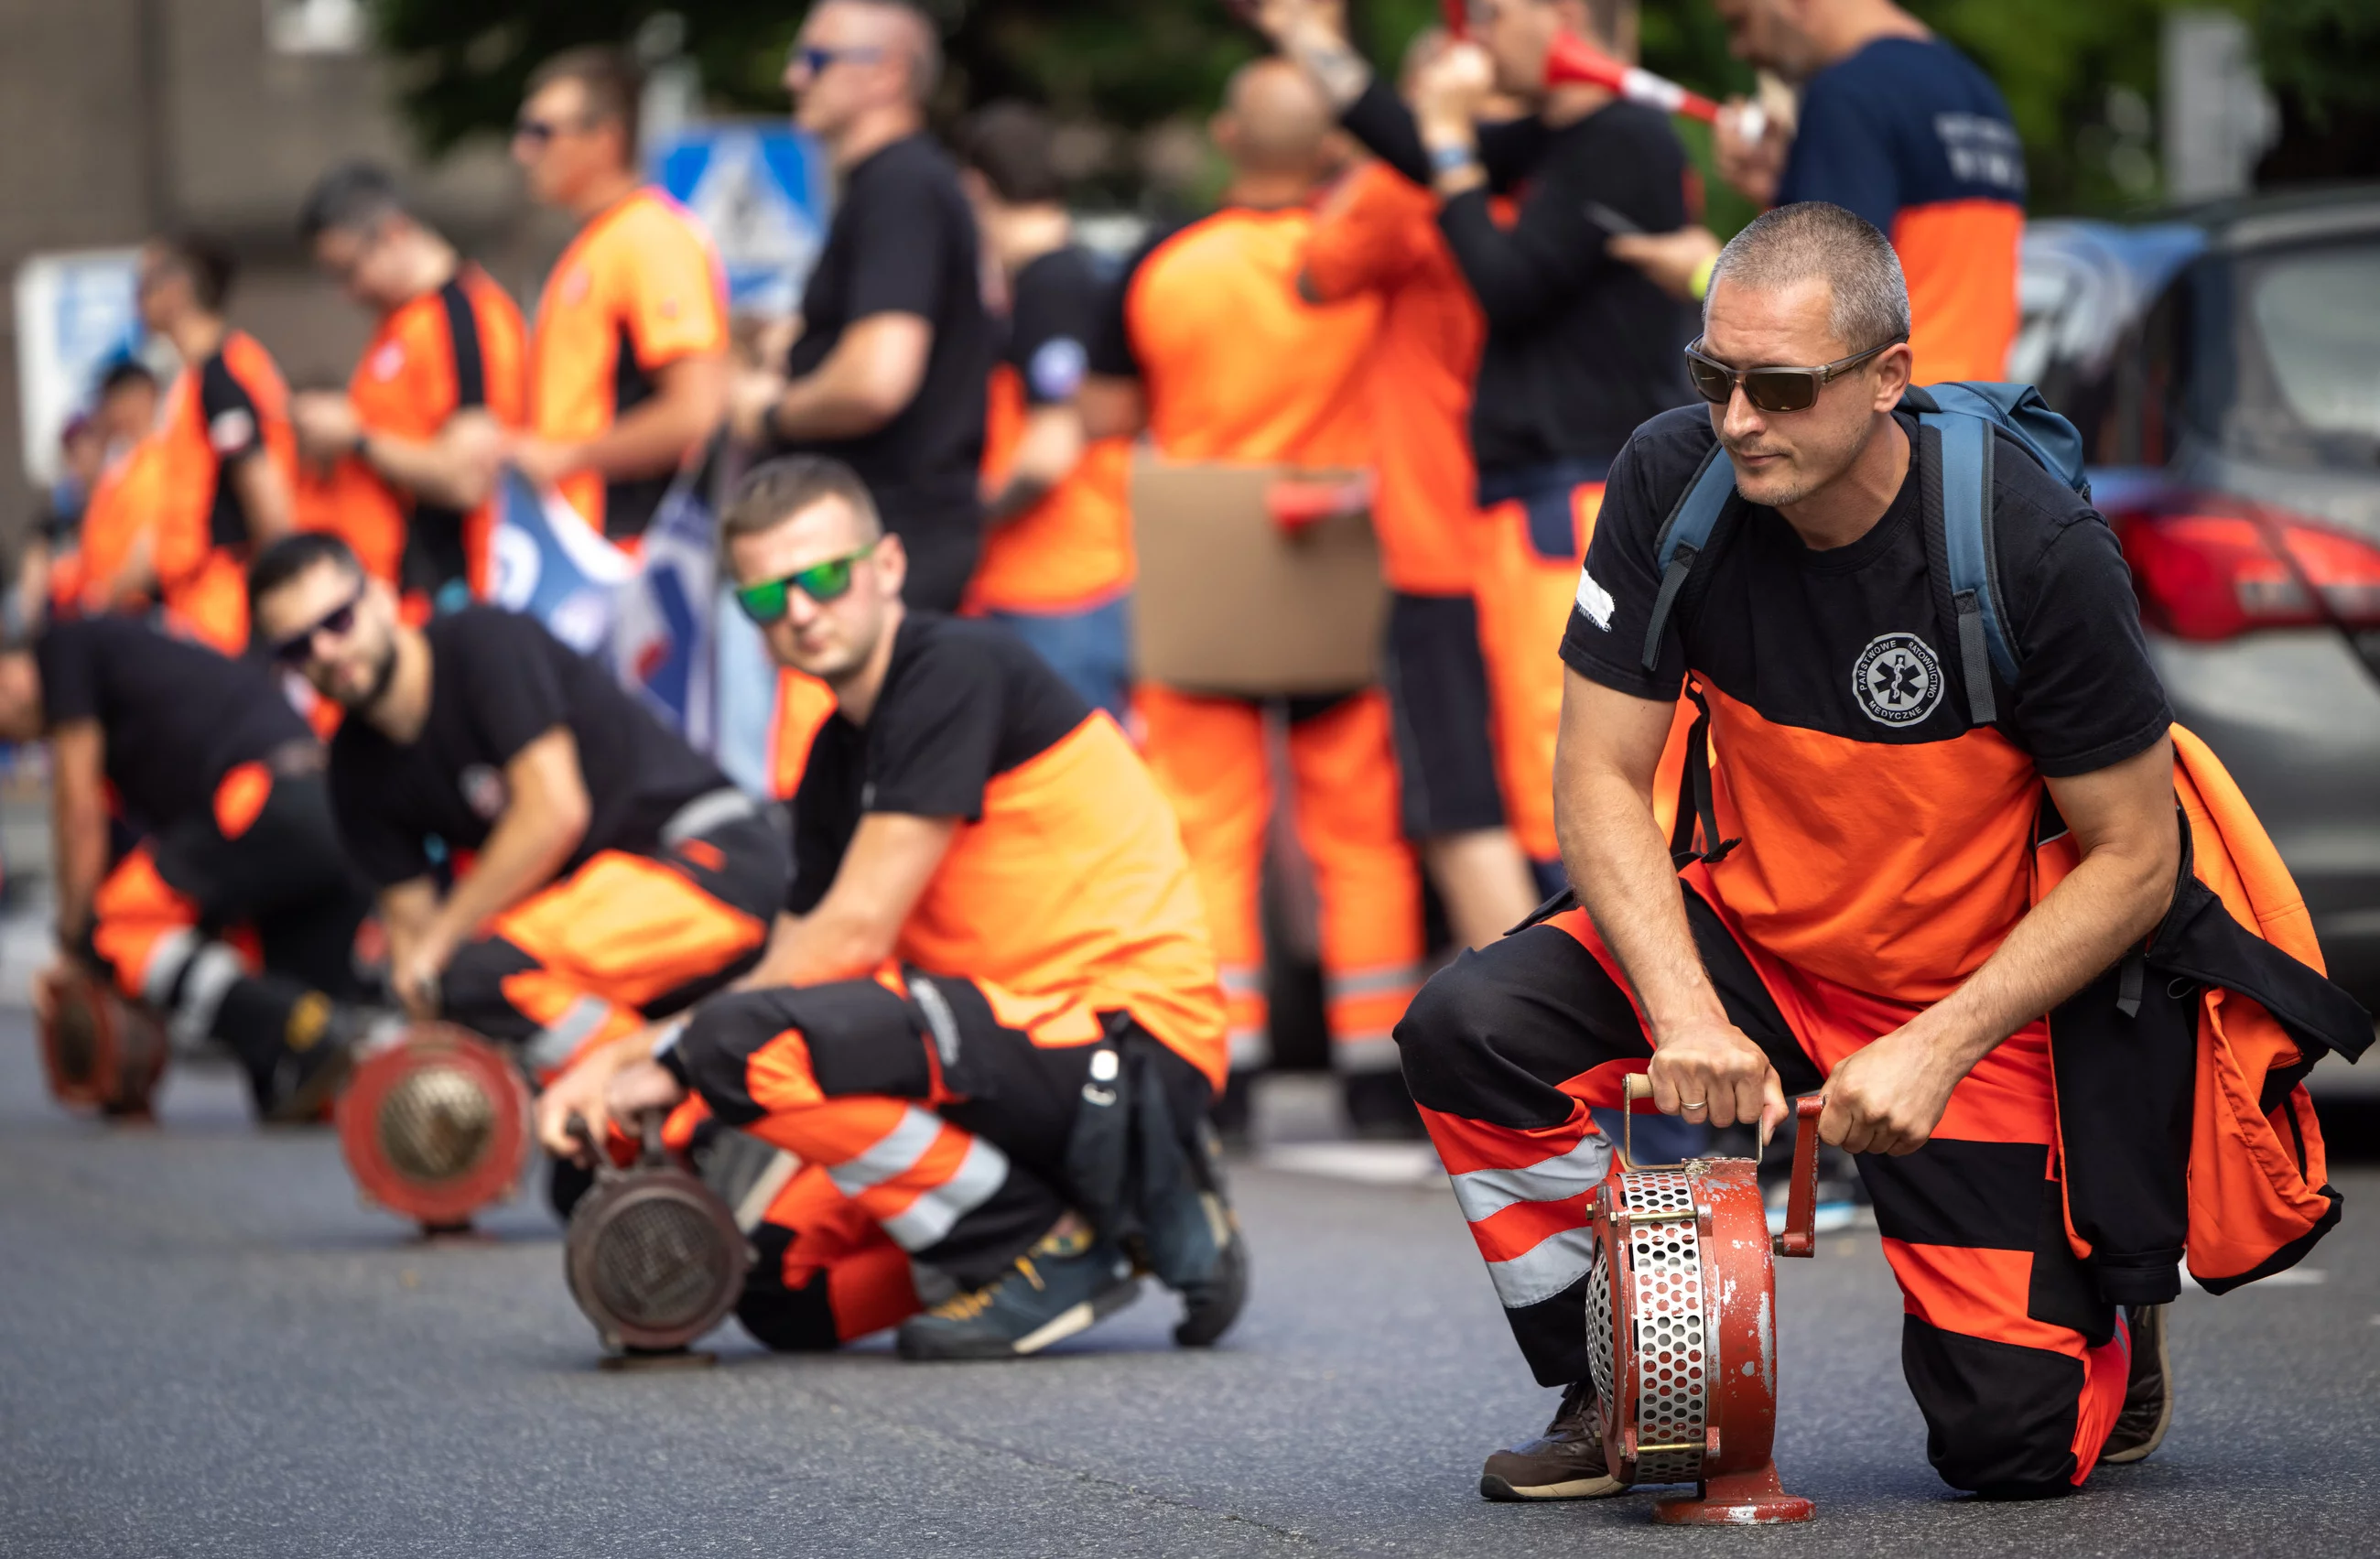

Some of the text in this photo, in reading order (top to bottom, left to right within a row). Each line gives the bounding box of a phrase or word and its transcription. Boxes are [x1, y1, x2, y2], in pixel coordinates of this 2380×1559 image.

[1858, 640, 1938, 698] PAŃSTWOWE RATOWNICTWO
[1868, 700, 1923, 720] MEDYCZNE
